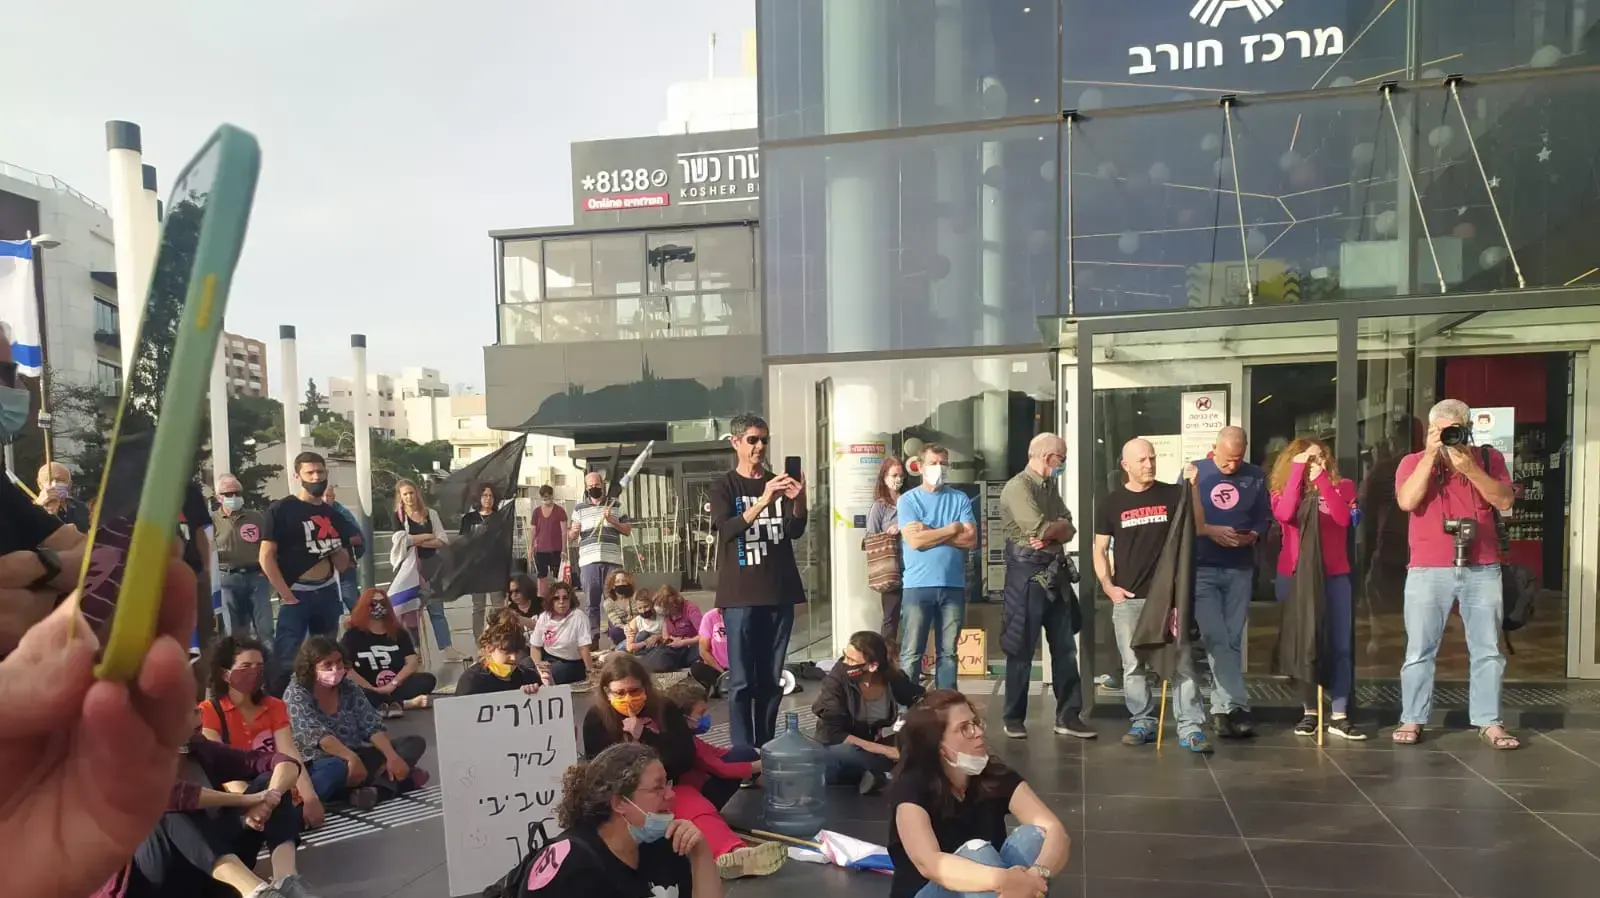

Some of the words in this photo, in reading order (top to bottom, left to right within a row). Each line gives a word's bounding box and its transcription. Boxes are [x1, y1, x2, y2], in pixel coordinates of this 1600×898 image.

[1128, 39, 1224, 75] חורב
[1240, 26, 1343, 64] מרכז
[678, 156, 722, 184] כשר
[588, 197, 623, 209] Online
[680, 185, 737, 198] KOSHER
[1120, 505, 1168, 521] CRIME
[476, 696, 564, 727] חוזרים
[479, 789, 555, 816] שביבי
